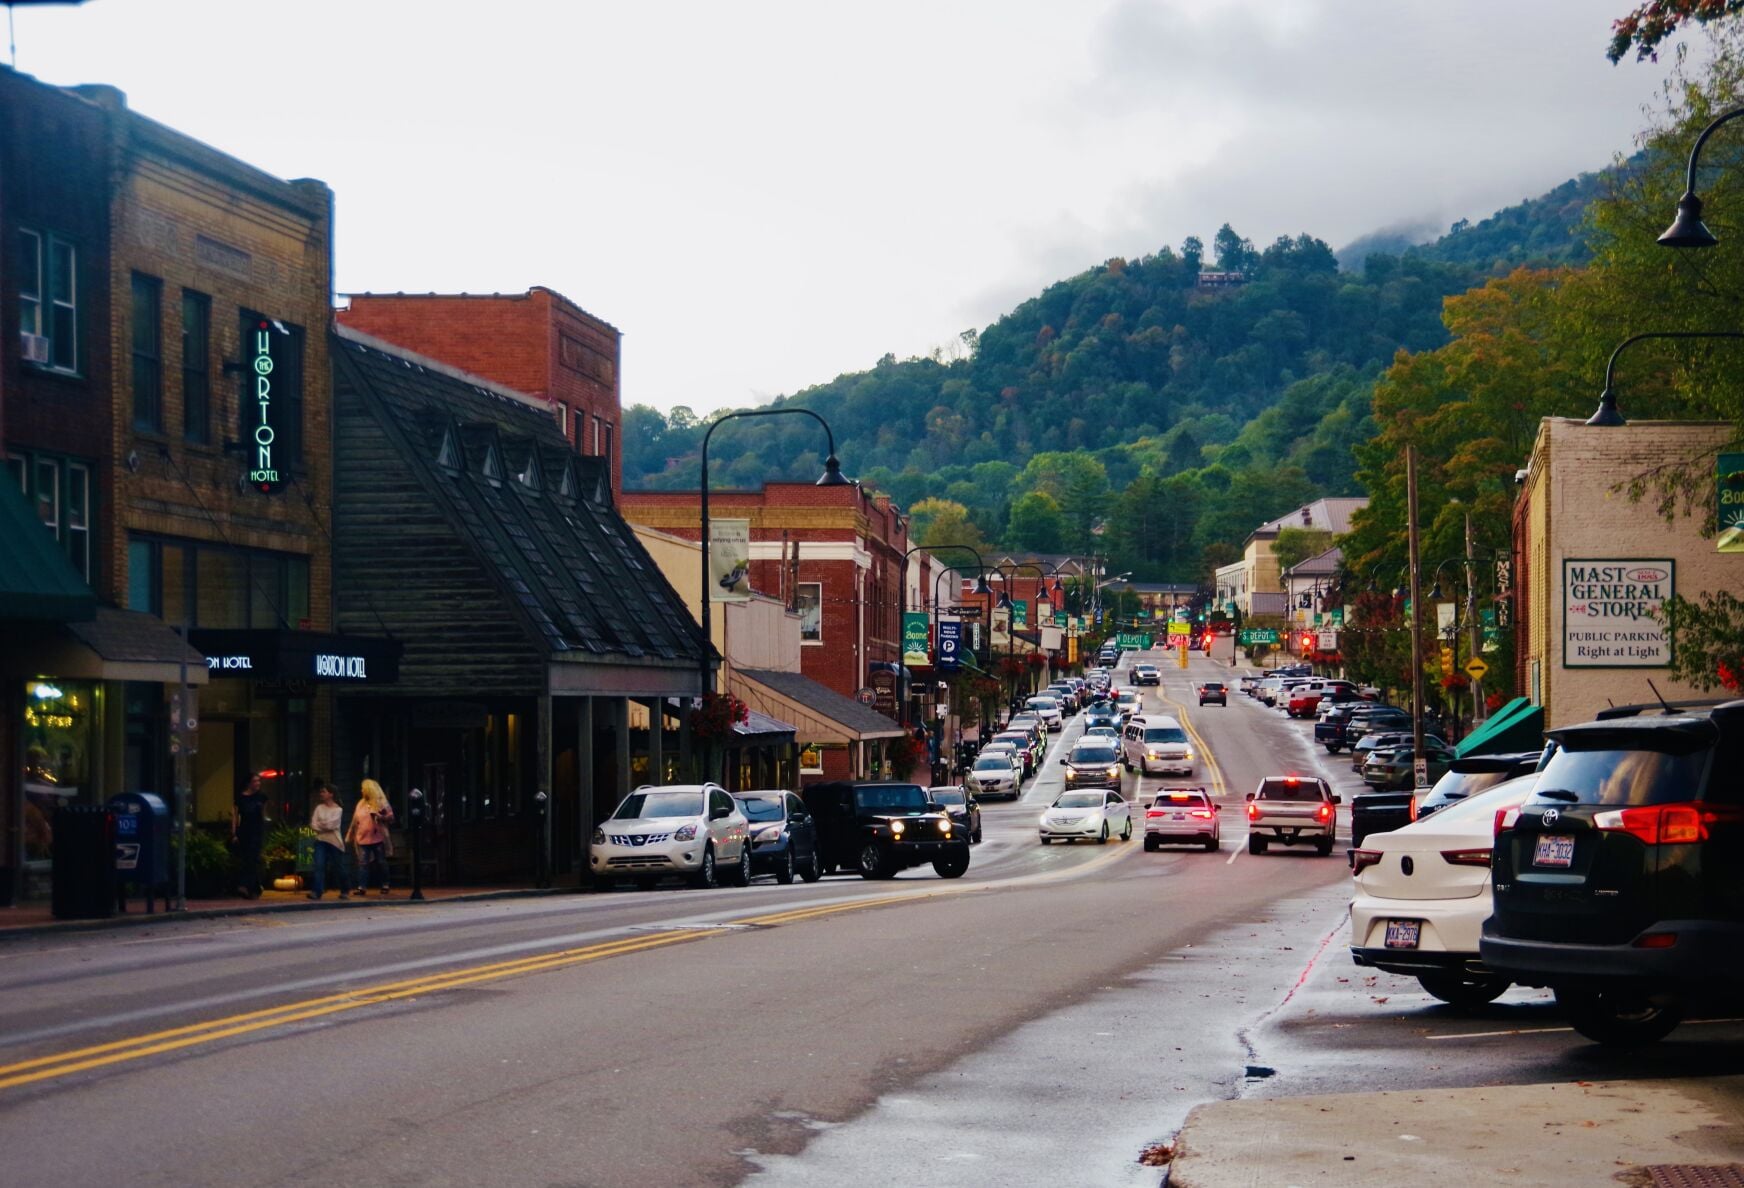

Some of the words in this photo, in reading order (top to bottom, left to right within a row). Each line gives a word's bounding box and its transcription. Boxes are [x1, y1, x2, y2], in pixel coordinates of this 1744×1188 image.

[254, 331, 275, 468] HORTON
[250, 470, 280, 483] HOTEL
[1496, 560, 1510, 593] MAST
[1570, 567, 1626, 587] MAST
[1572, 584, 1665, 600] GENERAL
[1587, 601, 1648, 621] STORE
[905, 631, 928, 640] Boone
[1122, 634, 1142, 644] DEPOT
[1250, 631, 1270, 640] DEPOT
[1569, 632, 1612, 641] PUBLIC
[1614, 632, 1669, 641] PARKING
[945, 641, 953, 651] P
[1577, 646, 1611, 660] Right
[1613, 648, 1625, 657] at
[1628, 646, 1660, 660] Light
[223, 656, 253, 669] HOTEL
[316, 654, 346, 677] HORTON
[346, 656, 367, 679] HOTEL
